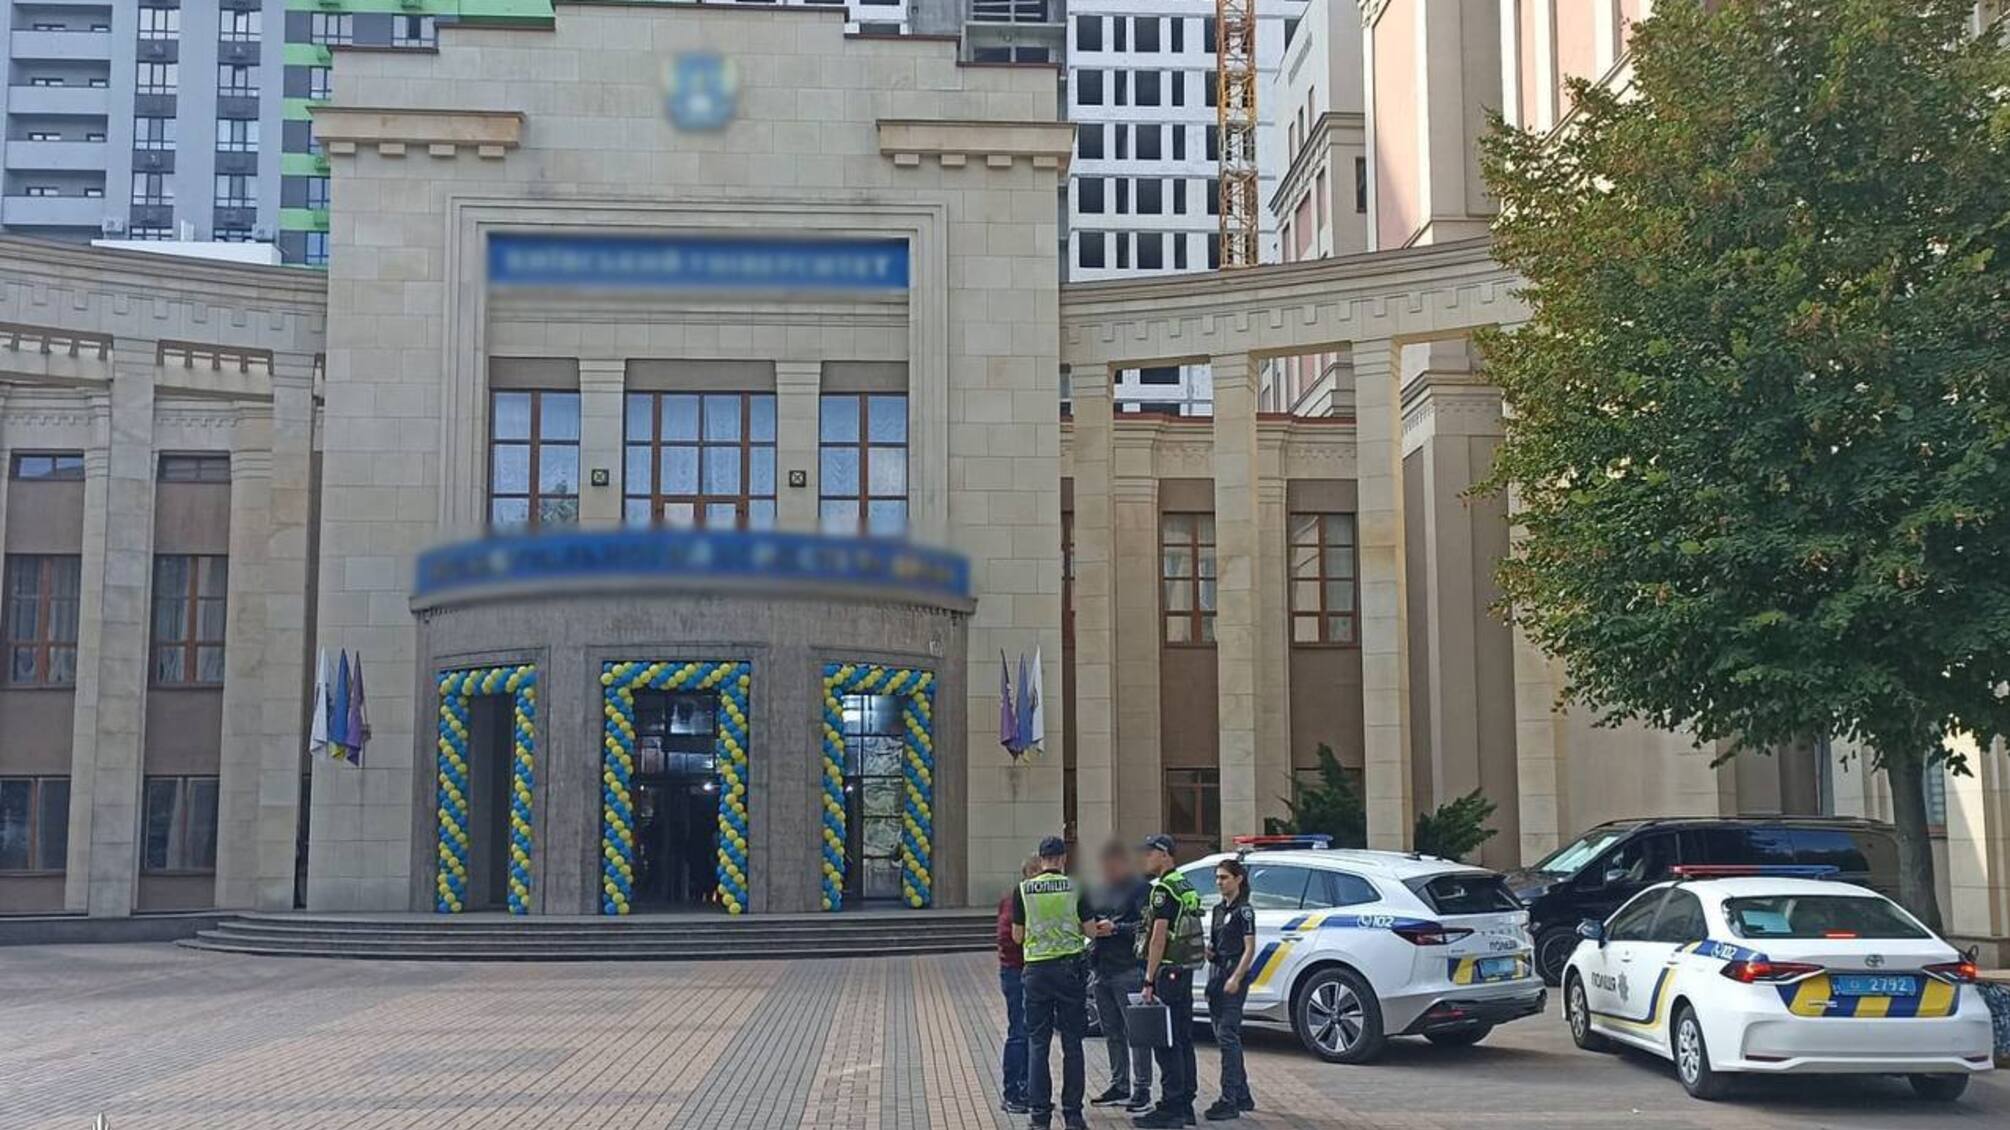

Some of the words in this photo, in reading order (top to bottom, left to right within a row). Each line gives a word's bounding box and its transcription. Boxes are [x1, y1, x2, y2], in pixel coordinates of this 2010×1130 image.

[1373, 915, 1394, 928] 102
[1720, 944, 1737, 960] 102
[1868, 977, 1909, 993] 2792
